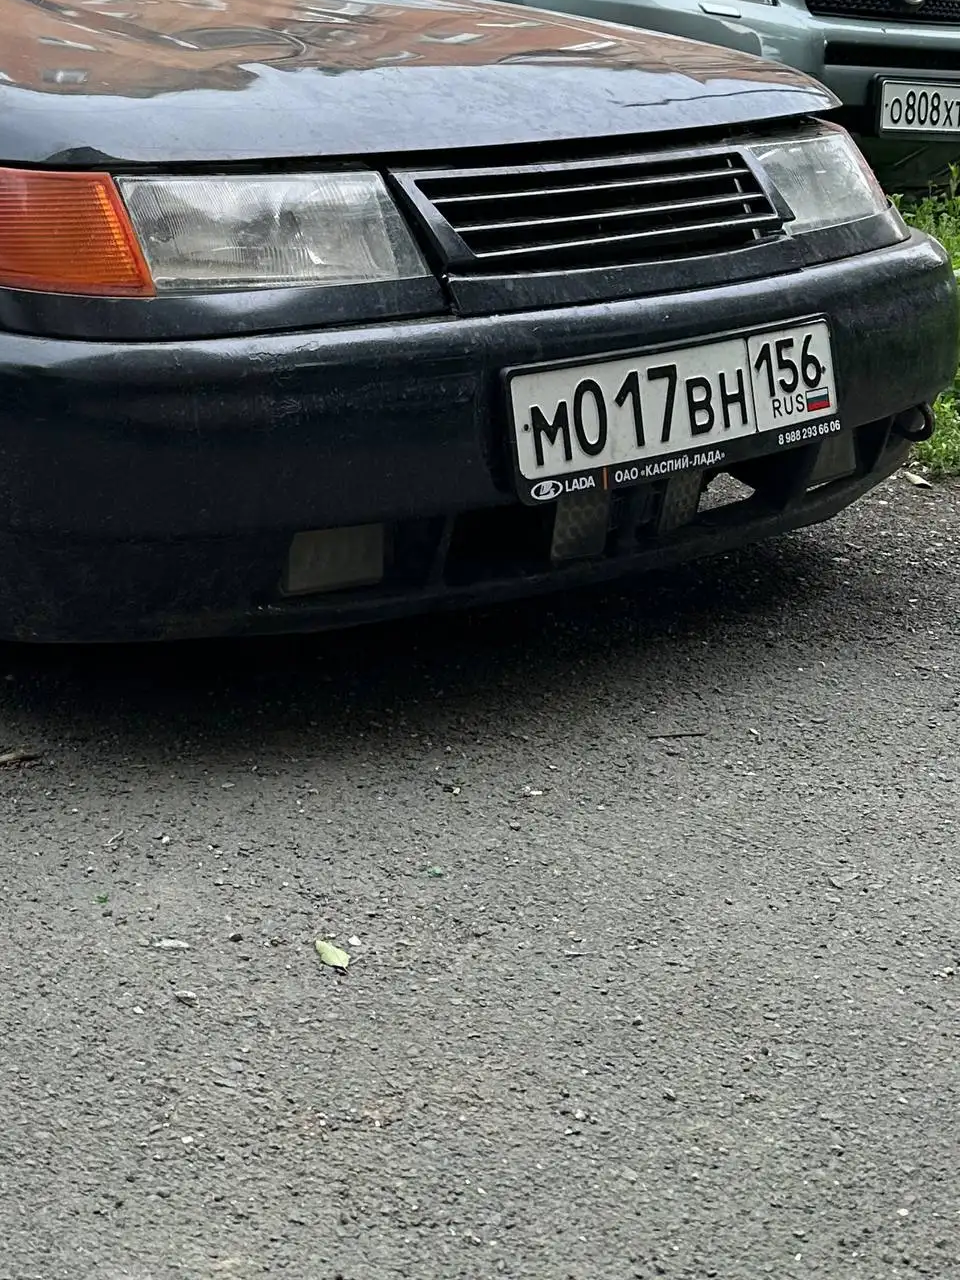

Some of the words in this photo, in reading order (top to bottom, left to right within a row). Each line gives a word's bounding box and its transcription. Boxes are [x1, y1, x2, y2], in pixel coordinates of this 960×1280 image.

[754, 334, 822, 397] 156
[772, 394, 805, 419] RUS
[778, 434, 785, 445] 8
[785, 429, 801, 443] 988
[802, 425, 818, 439] 293
[818, 422, 830, 435] 66
[830, 419, 841, 432] 06
[614, 467, 639, 483] ОАО
[640, 449, 726, 477] «КАСПИЙ-ЛАДА»
[565, 475, 596, 492] LADA
